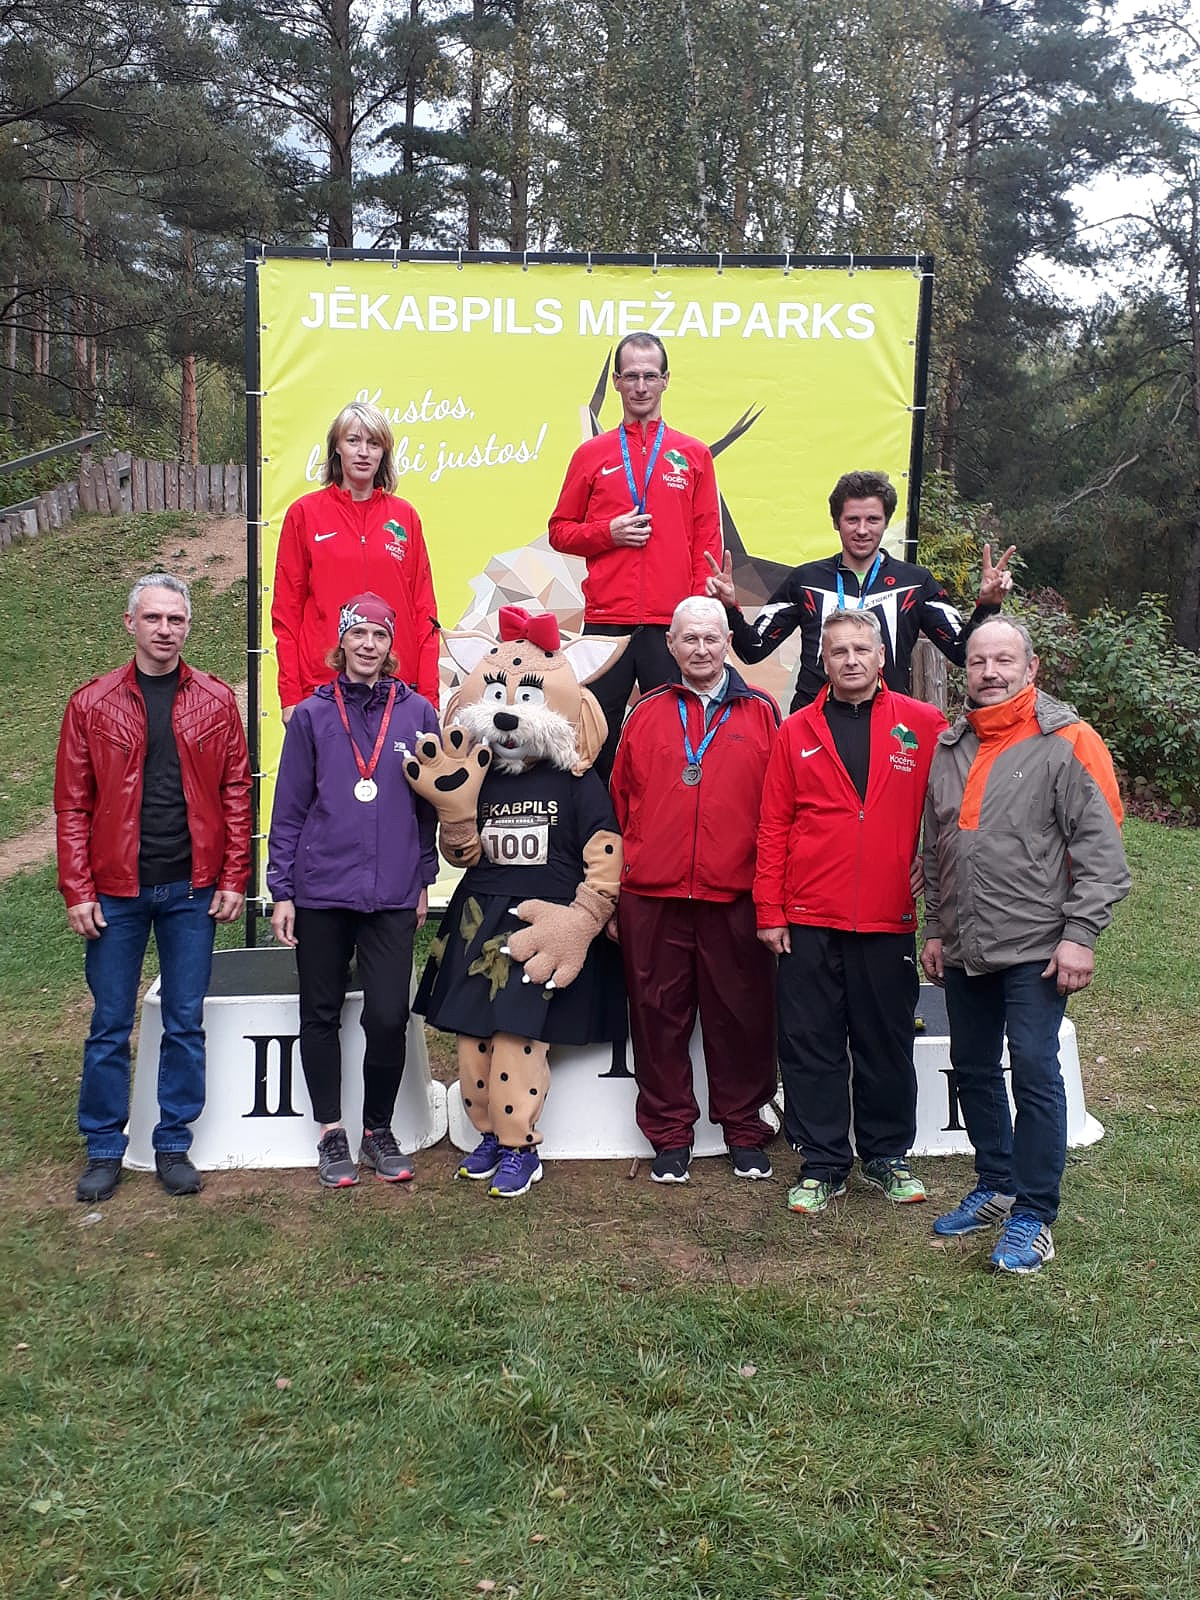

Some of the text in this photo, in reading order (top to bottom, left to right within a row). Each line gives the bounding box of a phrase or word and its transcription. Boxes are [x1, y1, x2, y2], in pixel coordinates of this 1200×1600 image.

[300, 285, 877, 340] JĒKABPILS MEŽAPARKS
[430, 422, 549, 483] justos!
[488, 833, 540, 860] 100
